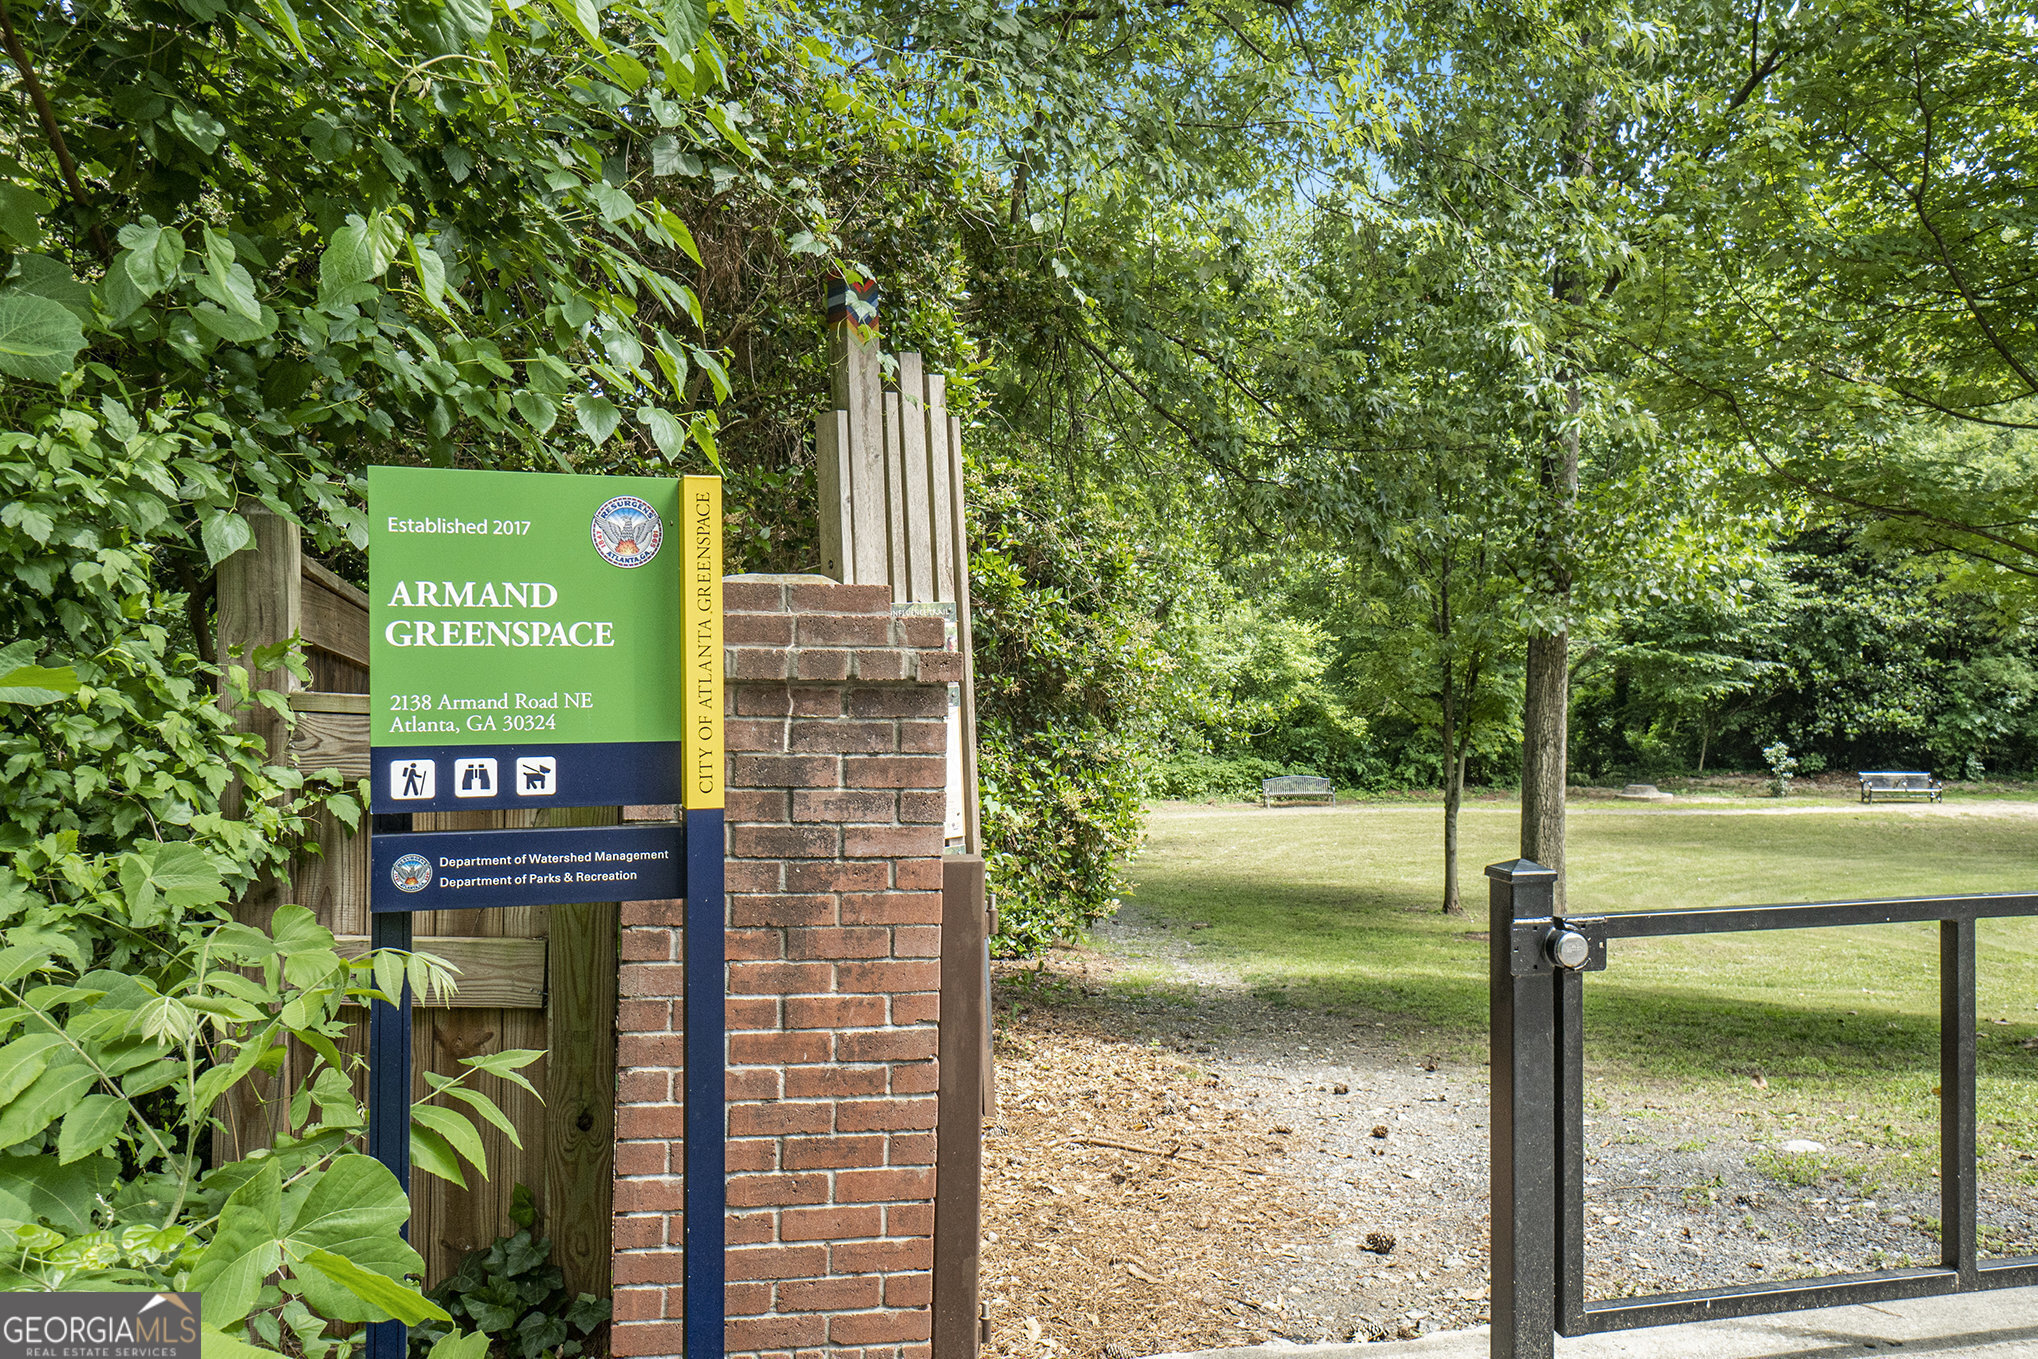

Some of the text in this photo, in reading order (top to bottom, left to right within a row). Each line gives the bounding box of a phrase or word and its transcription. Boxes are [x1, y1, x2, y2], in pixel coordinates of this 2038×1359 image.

[600, 500, 653, 519] RESURGENS
[387, 517, 531, 536] Established 2017
[387, 580, 558, 608] ARMAND
[929, 607, 950, 616] TRAIL
[385, 620, 615, 648] GREENSPACE
[696, 491, 714, 794] CITY OF ATLANTA GREENSPACE
[390, 692, 594, 712] 2138 Armand Road NE
[389, 713, 557, 734] Atlanta, GA 30324
[439, 855, 512, 868] Department
[514, 854, 528, 866] of
[528, 851, 592, 864] Watershed
[594, 850, 669, 865] Management
[439, 875, 512, 889] Department
[513, 874, 528, 886] of
[529, 873, 562, 885] Parks
[564, 872, 574, 883] &
[576, 870, 638, 882] Recreation
